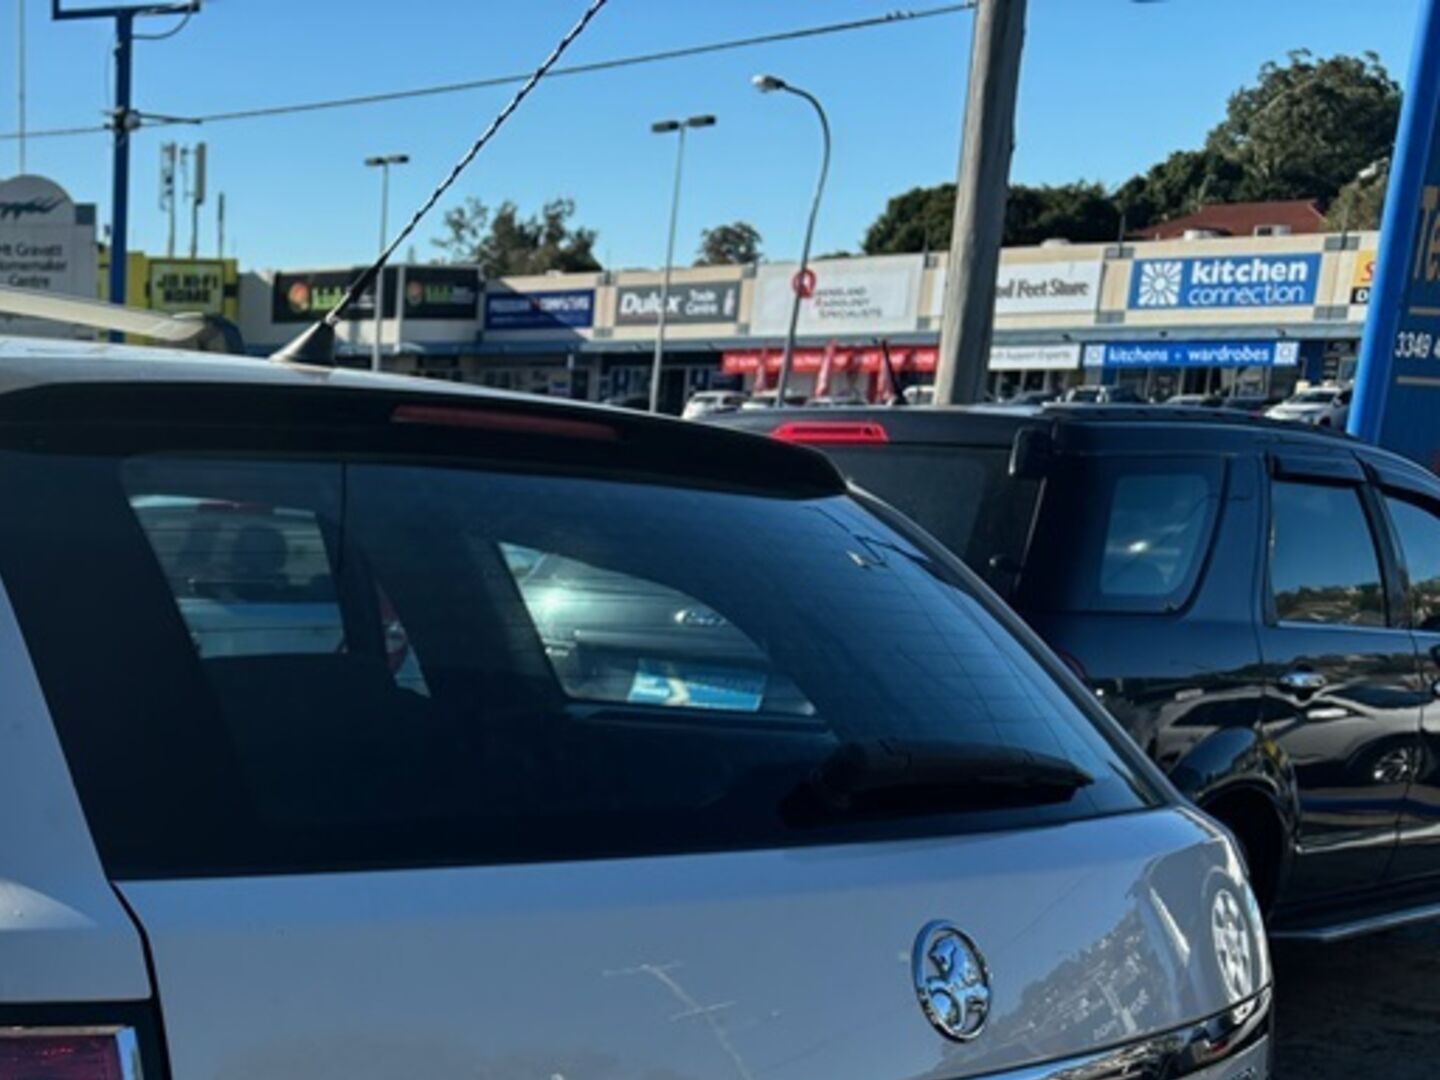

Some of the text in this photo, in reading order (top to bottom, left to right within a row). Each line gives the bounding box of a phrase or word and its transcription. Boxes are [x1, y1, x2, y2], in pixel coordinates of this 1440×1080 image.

[1191, 258, 1309, 284] kitchen
[1016, 279, 1047, 298] Feet
[1048, 278, 1089, 297] Store
[1187, 283, 1305, 305] connection
[1110, 342, 1270, 362] kitchens wardrobes
